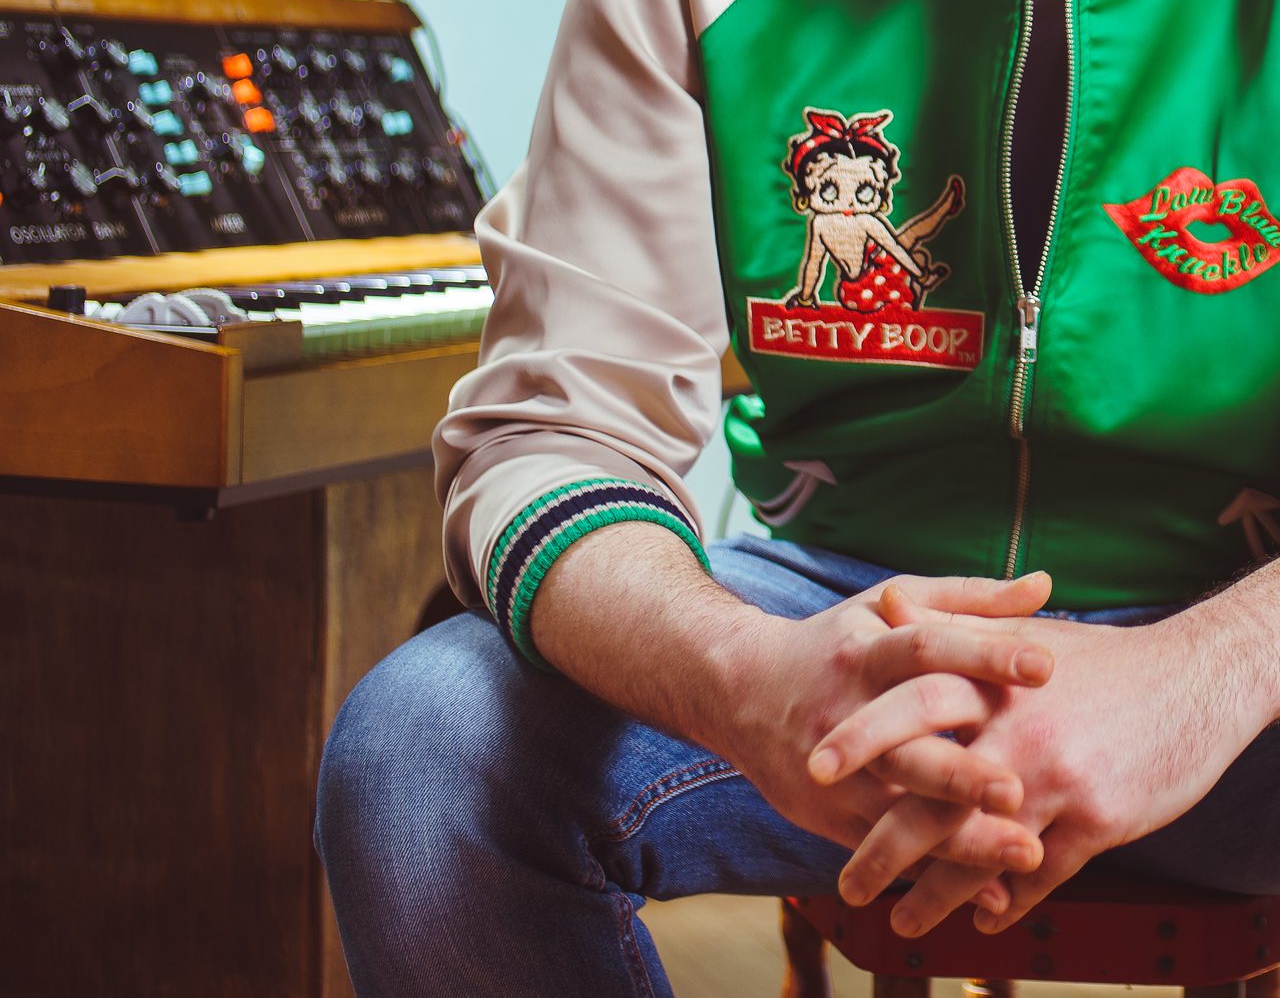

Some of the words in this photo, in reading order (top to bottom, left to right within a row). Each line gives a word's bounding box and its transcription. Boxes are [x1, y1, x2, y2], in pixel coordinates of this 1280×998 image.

[1138, 186, 1215, 223] Low
[762, 316, 874, 350] BETTY
[880, 323, 969, 355] BOOP
